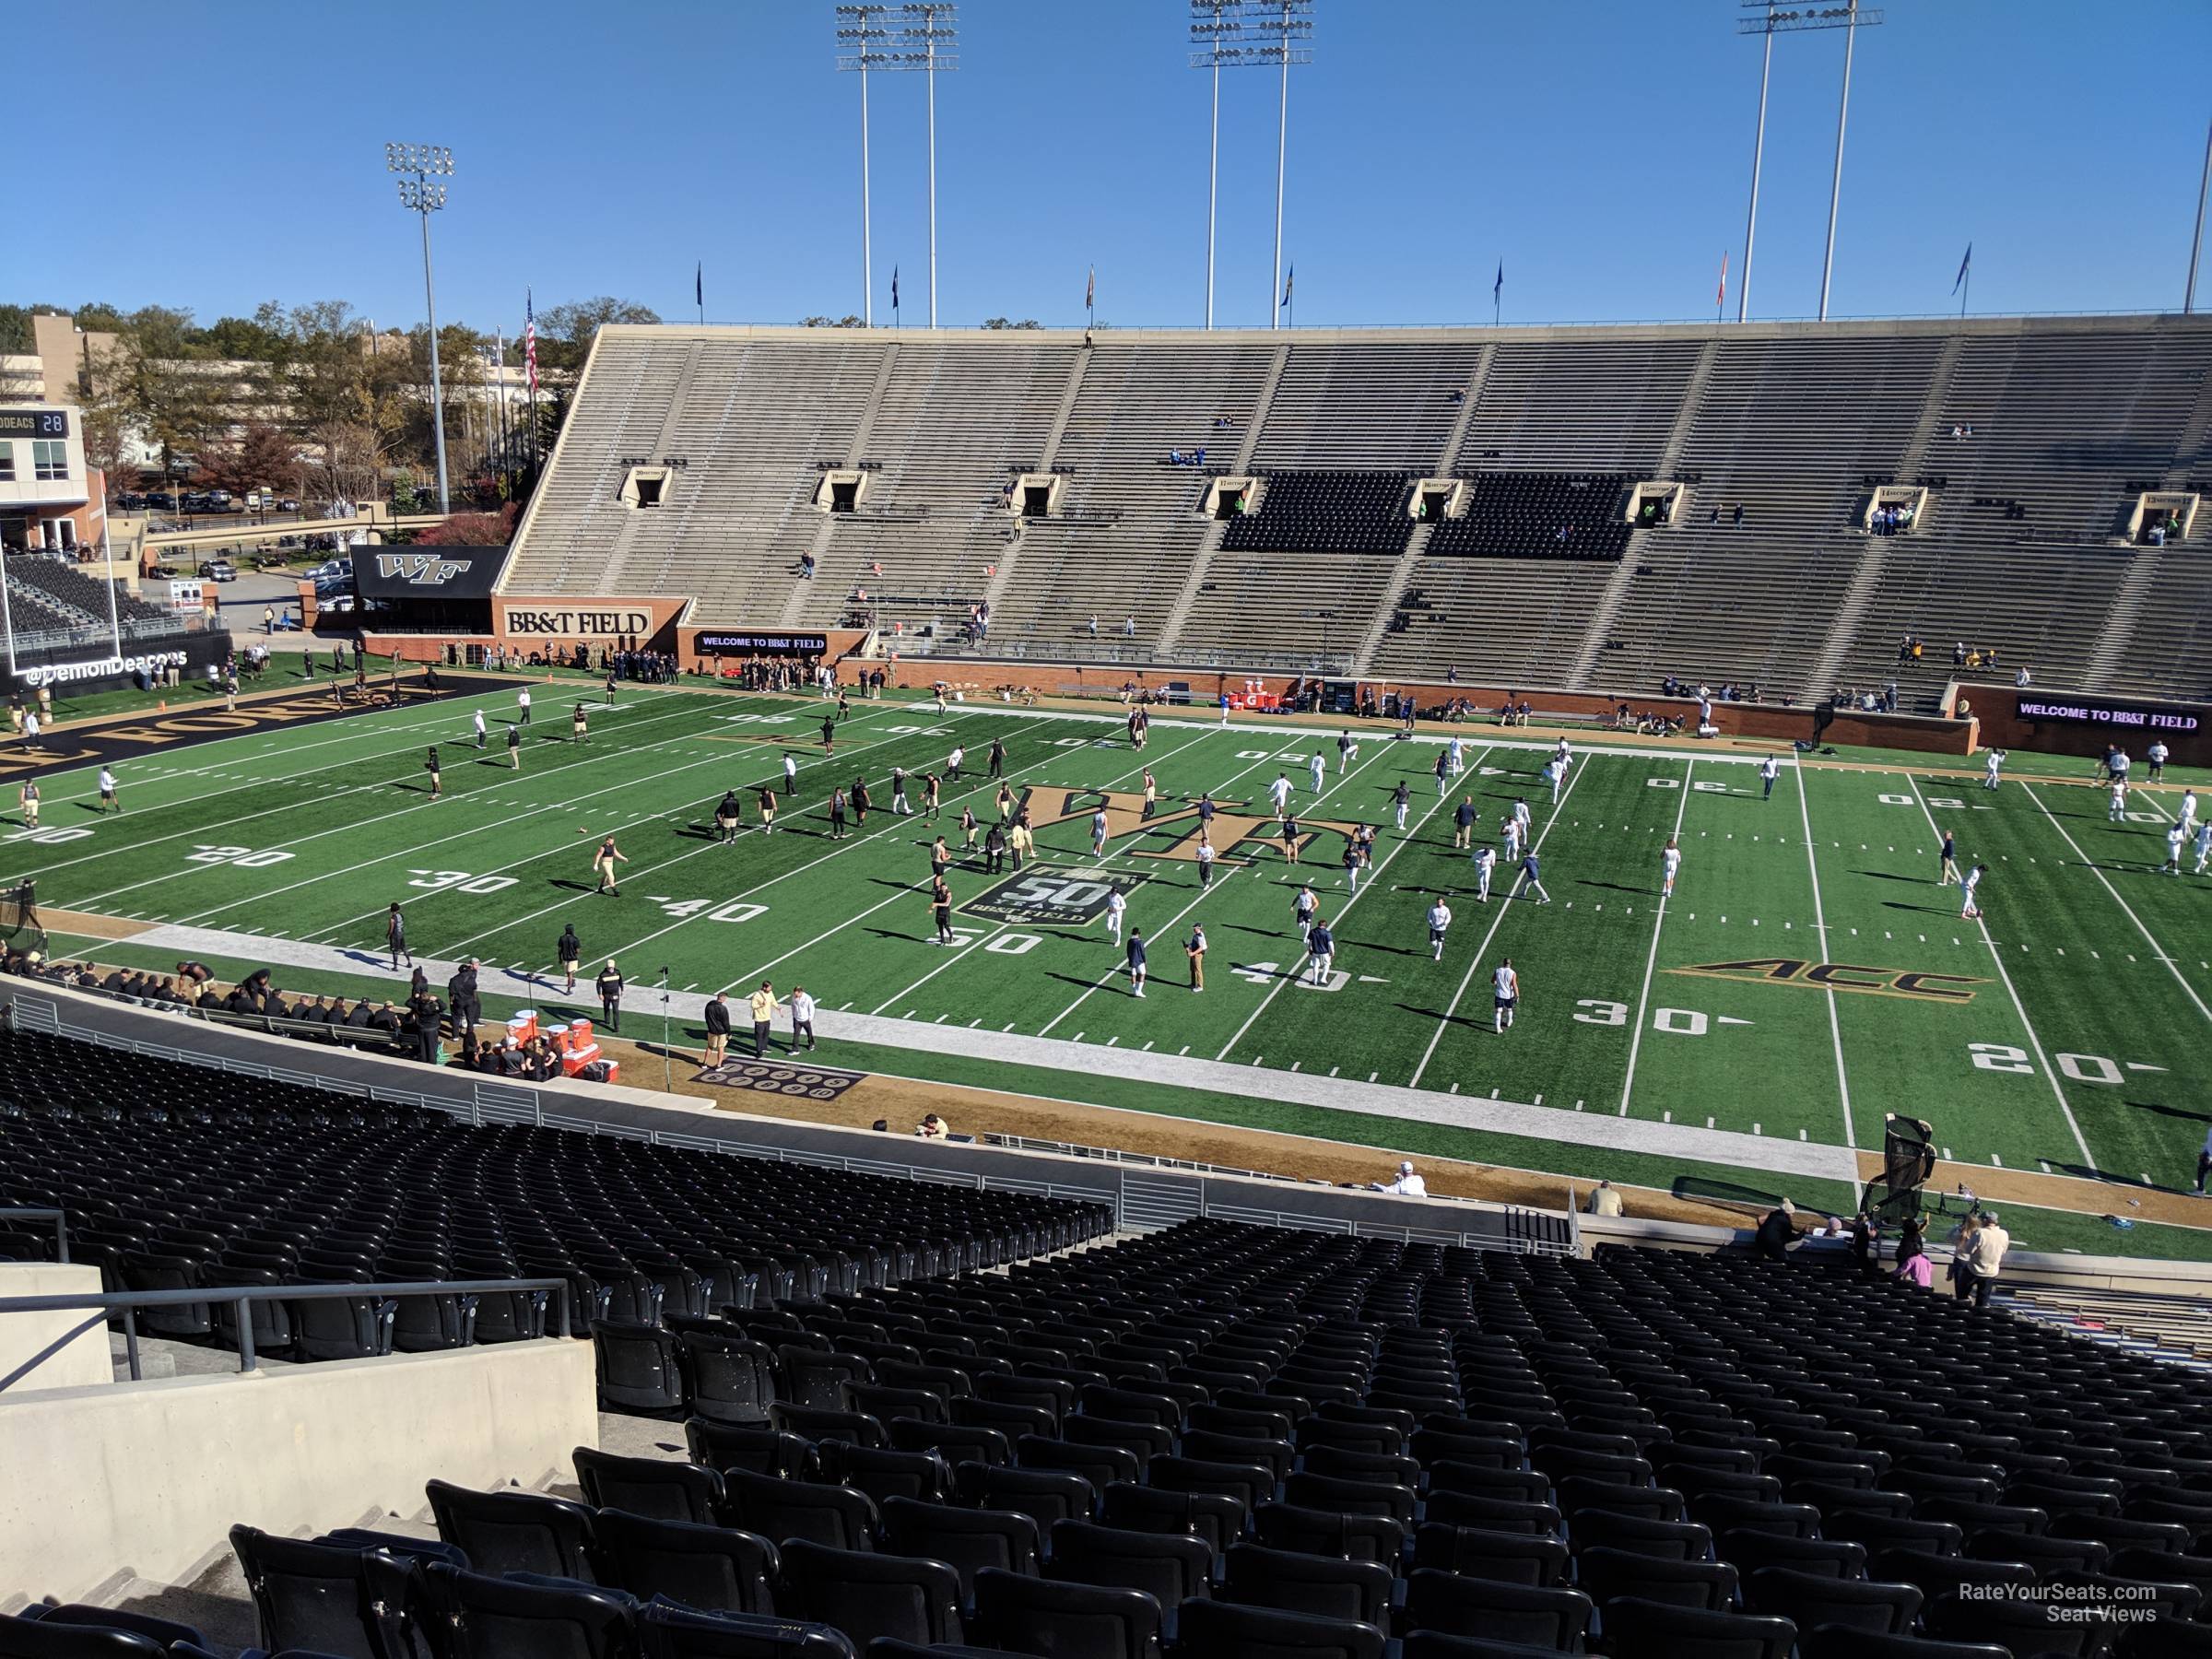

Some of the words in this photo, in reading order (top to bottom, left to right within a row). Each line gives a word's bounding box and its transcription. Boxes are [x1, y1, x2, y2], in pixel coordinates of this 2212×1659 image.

[43, 416, 63, 431] 28
[376, 554, 472, 584] WF
[507, 611, 574, 634] BB&T
[577, 612, 648, 634] FIELD
[702, 637, 751, 647] WELCOME
[752, 638, 767, 647] TO
[768, 638, 792, 648] BB&T
[794, 639, 825, 649] FIELD
[1246, 695, 1257, 706] G
[2020, 702, 2088, 719] WELCOME
[2090, 710, 2111, 721] TO
[2112, 711, 2148, 725] BB&T
[2149, 714, 2198, 729] FIELD
[1001, 877, 1113, 907] 50
[1020, 909, 1086, 922] FIELD
[1670, 958, 1997, 1001] ACC
